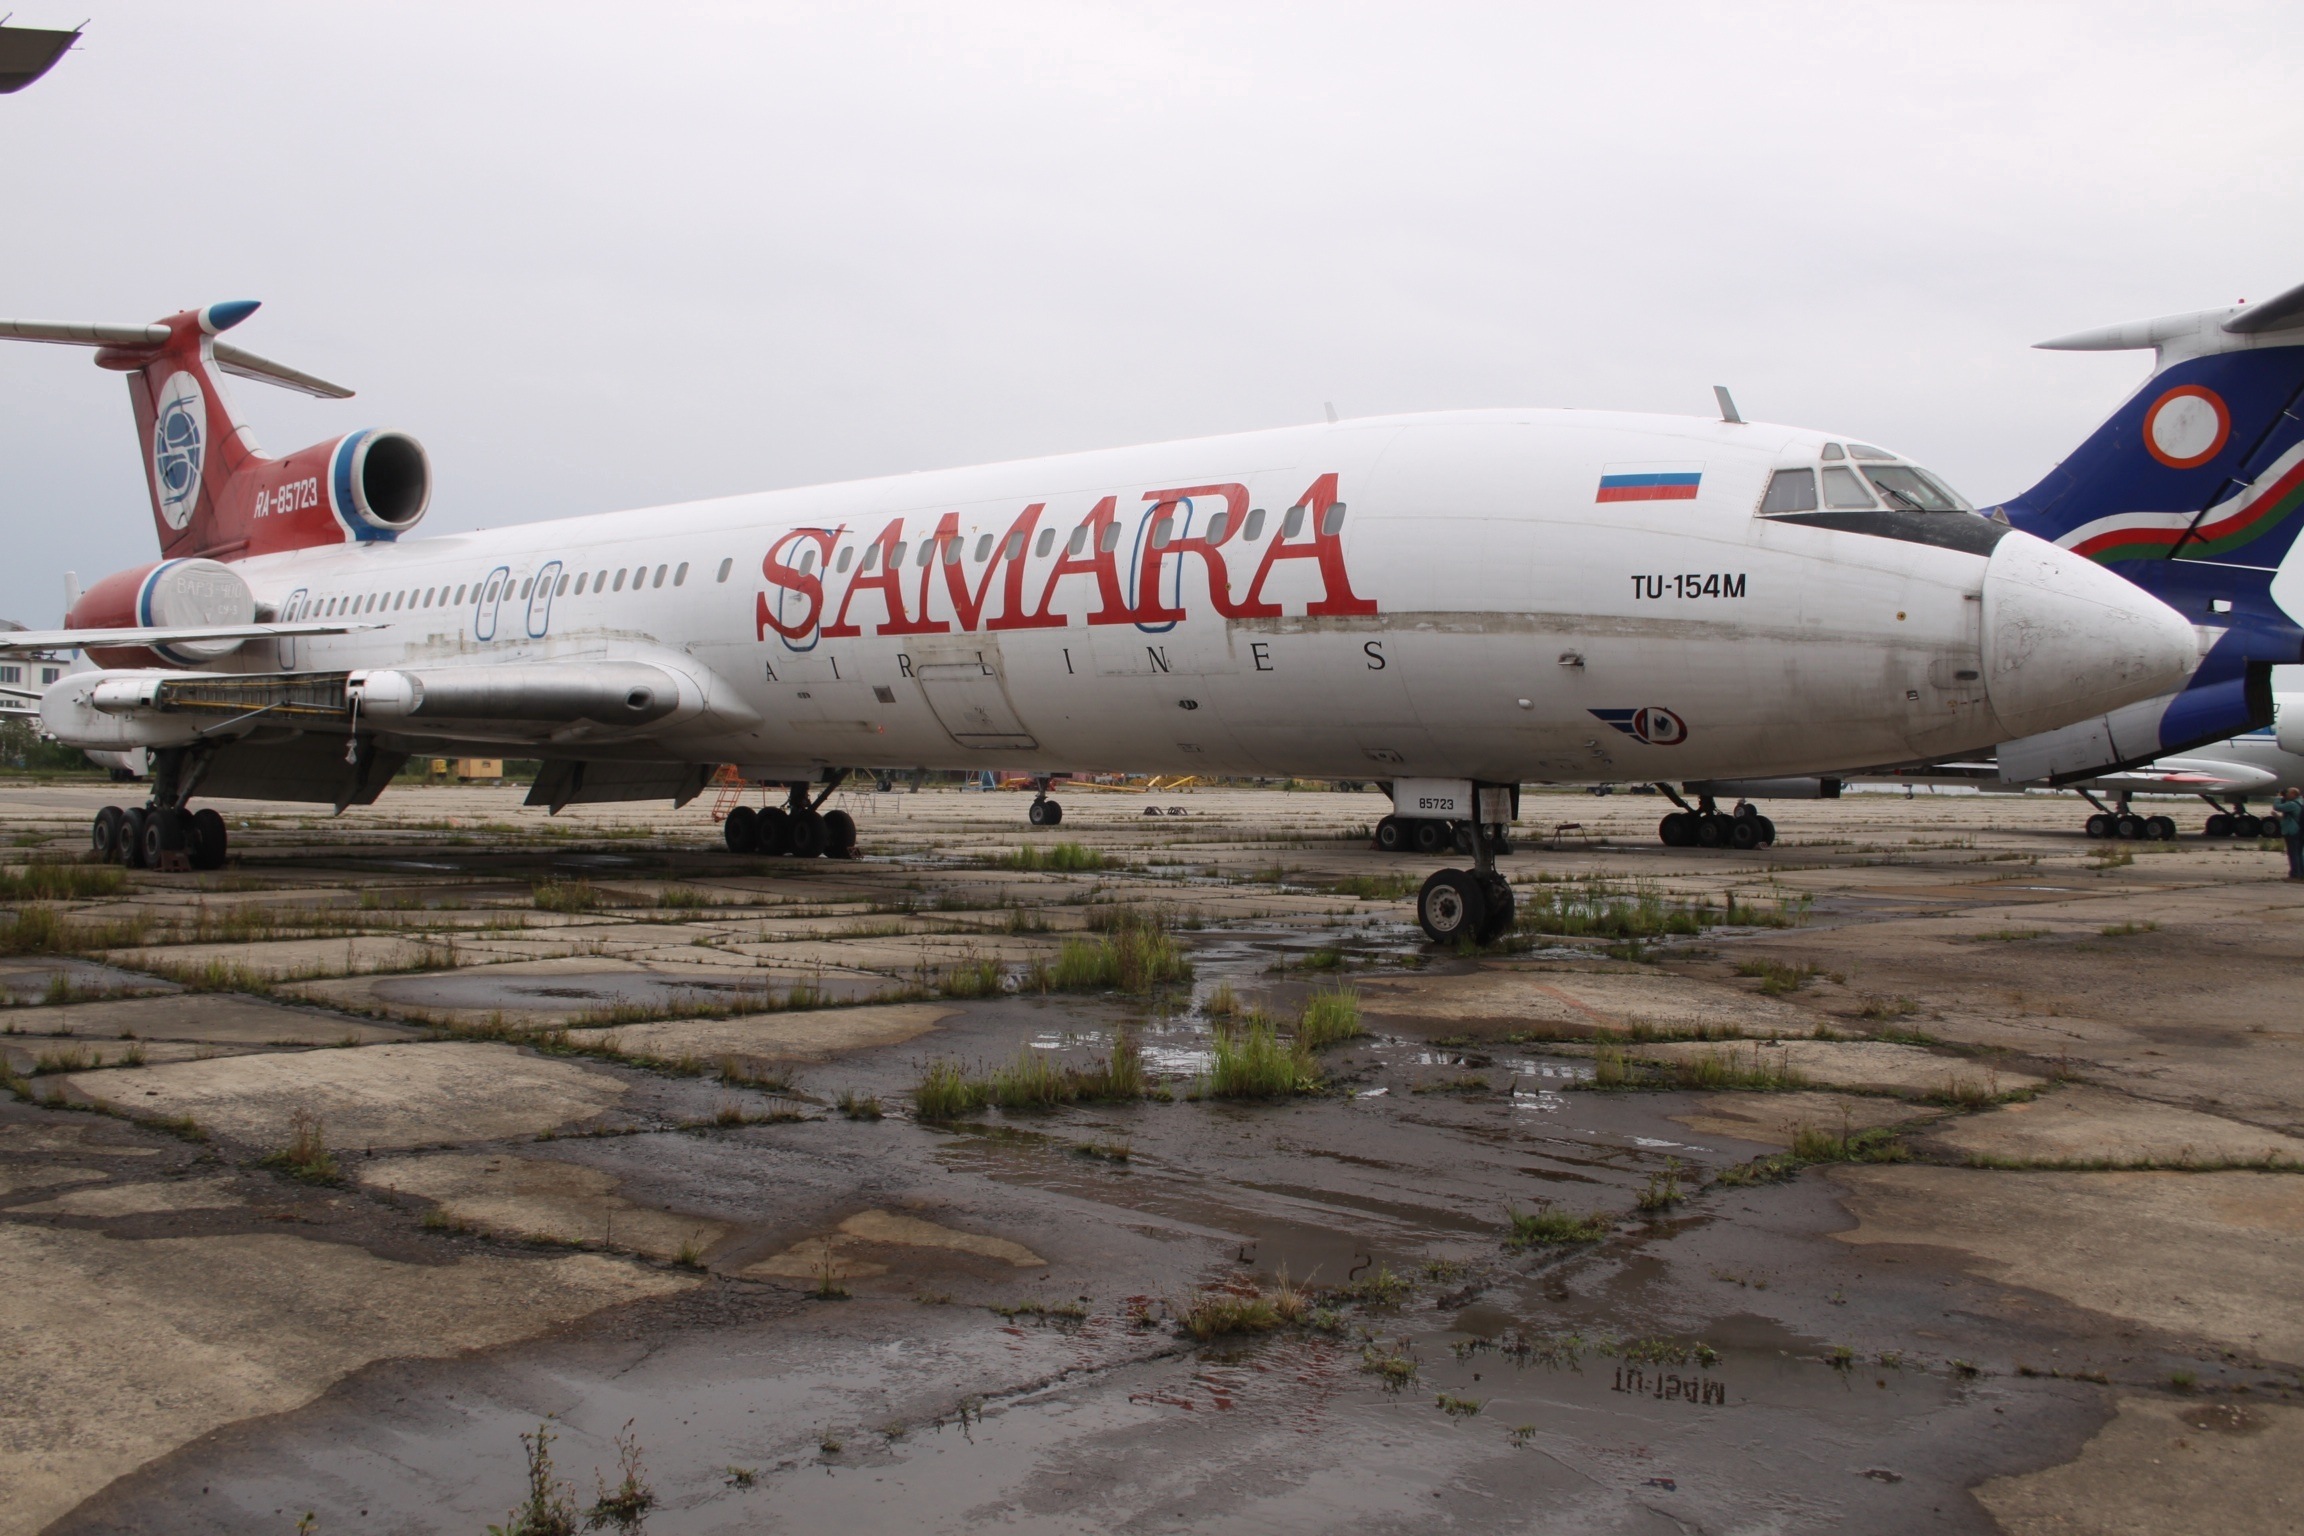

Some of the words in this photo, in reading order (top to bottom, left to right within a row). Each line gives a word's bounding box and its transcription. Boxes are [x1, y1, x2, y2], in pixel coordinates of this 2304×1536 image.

[253, 476, 318, 519] RA-85723
[756, 472, 1378, 642] SAMARA
[1631, 573, 1746, 599] TU-154M
[765, 640, 1387, 682] AIRLINES
[1419, 798, 1454, 810] 85723
